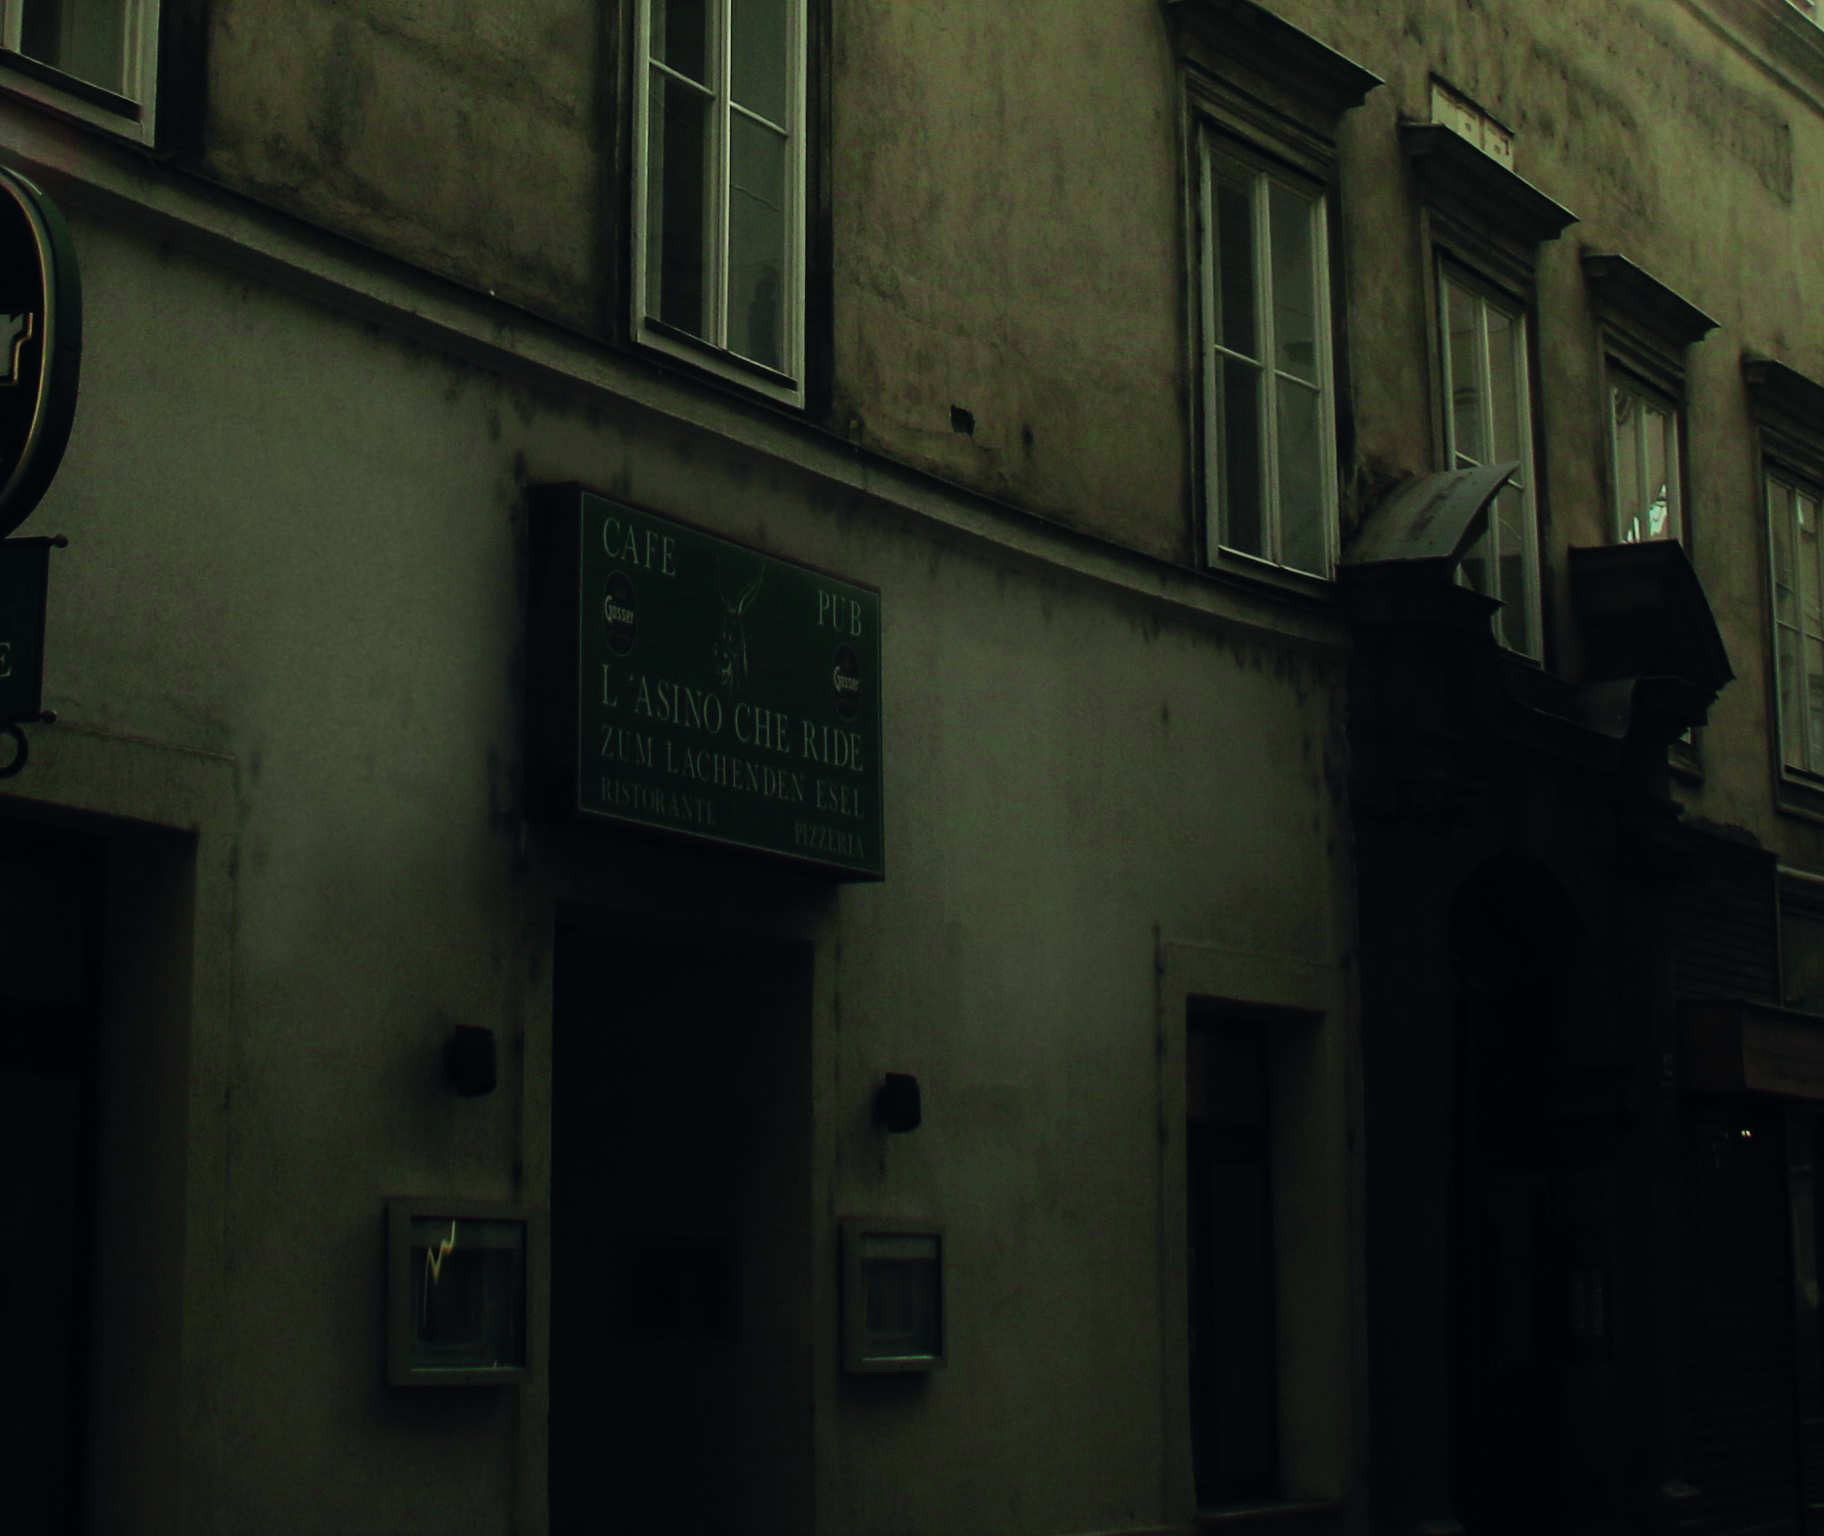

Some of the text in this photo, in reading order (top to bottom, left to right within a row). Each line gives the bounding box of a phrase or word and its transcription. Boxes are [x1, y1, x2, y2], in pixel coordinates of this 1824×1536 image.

[602, 516, 862, 637] CAFE PUB
[601, 725, 864, 819] ZUM LACHENDEN ESEL
[735, 702, 790, 754] CHE
[802, 720, 863, 772] RIDE
[601, 776, 865, 859] RISTORANTE PIZZERIA
